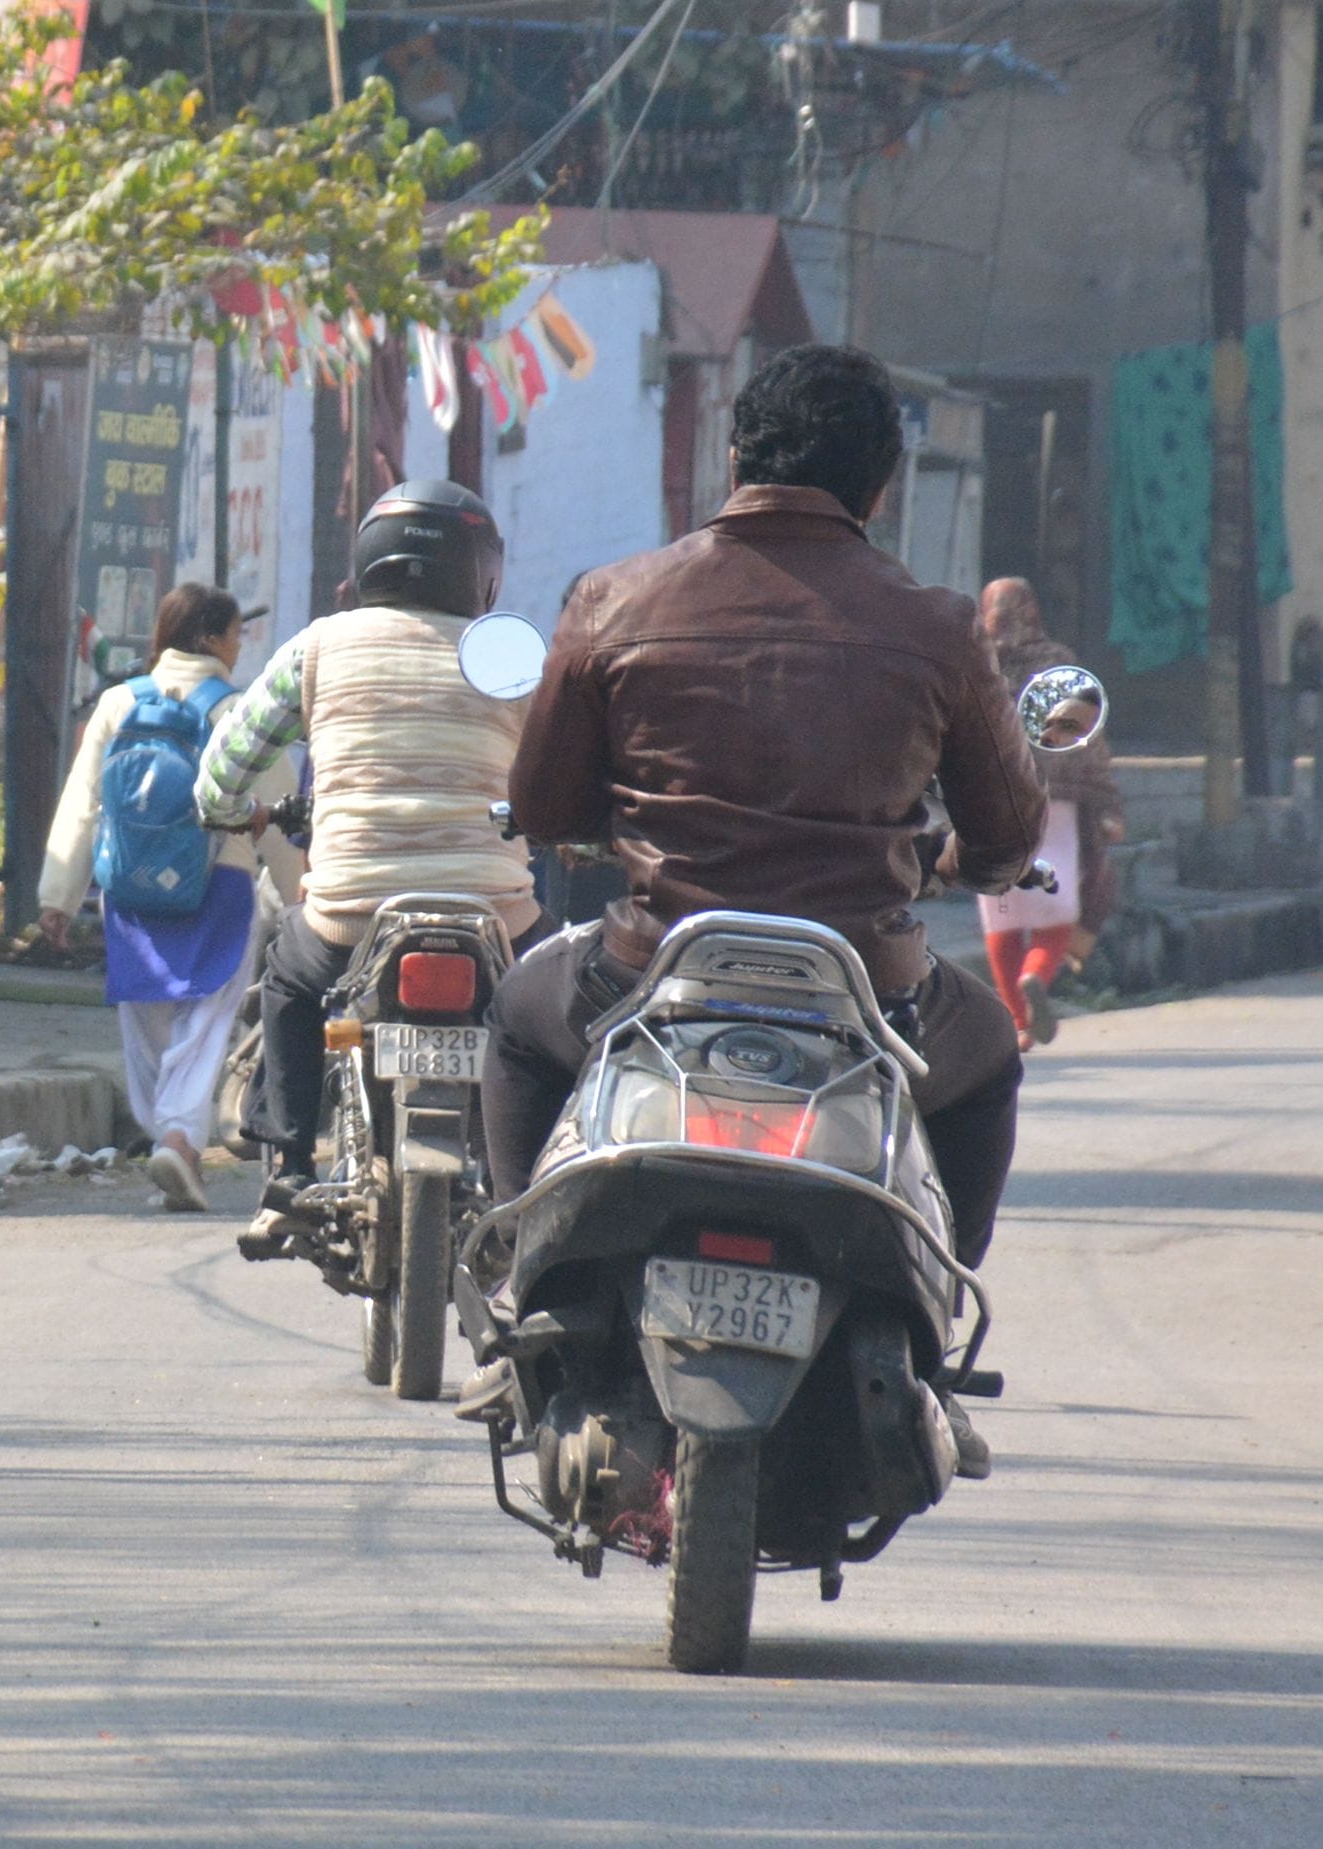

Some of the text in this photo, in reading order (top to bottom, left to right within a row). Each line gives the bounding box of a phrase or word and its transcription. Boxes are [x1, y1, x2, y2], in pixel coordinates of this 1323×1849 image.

[396, 1028, 478, 1050] UP32B
[397, 1051, 475, 1076] U6831
[737, 1050, 773, 1063] TVS
[688, 1266, 795, 1309] UP32K
